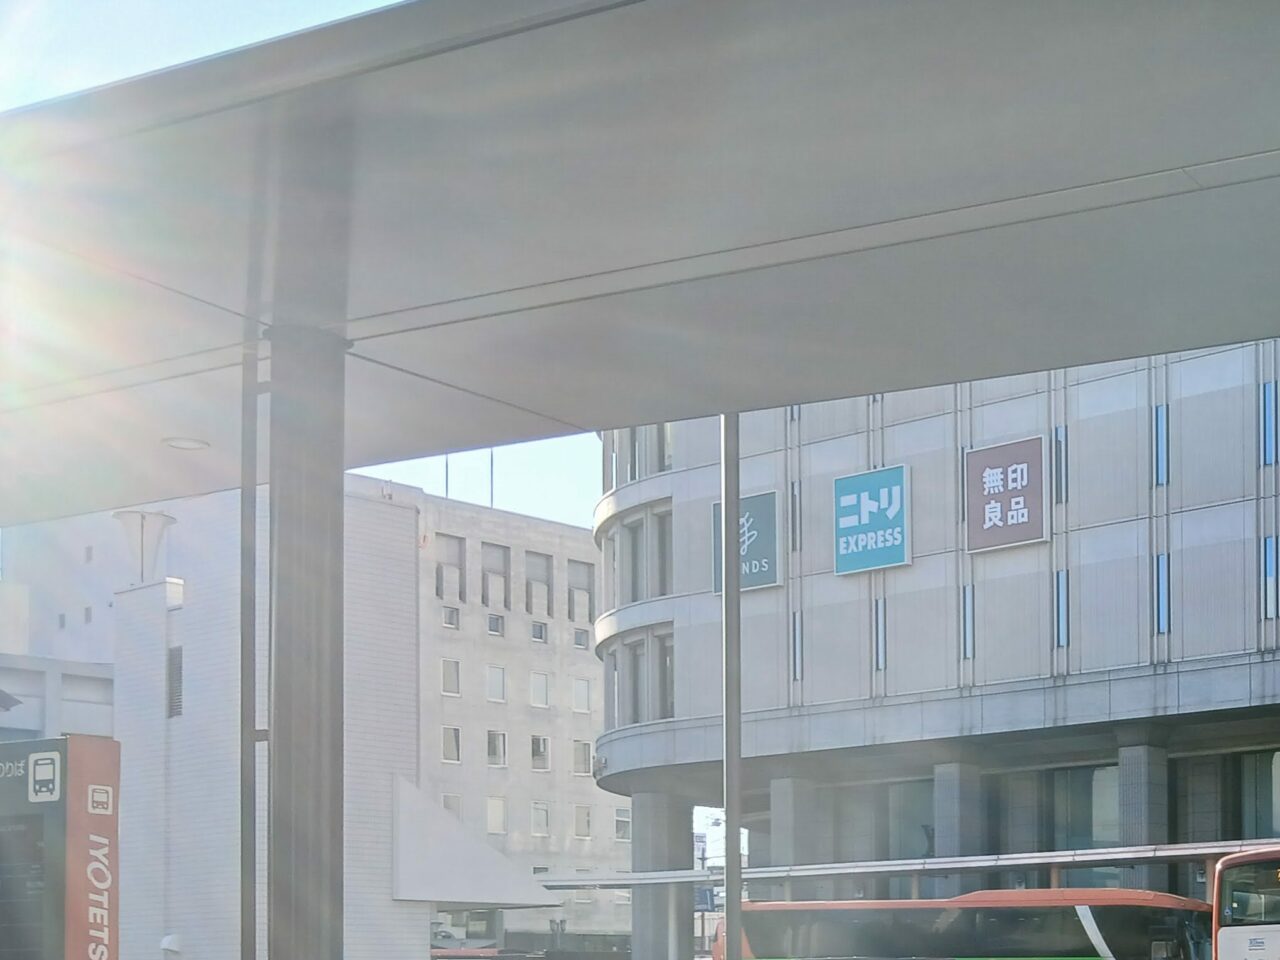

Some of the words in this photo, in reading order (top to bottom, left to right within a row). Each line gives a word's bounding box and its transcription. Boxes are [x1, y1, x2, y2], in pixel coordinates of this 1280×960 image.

[982, 462, 1029, 495] 無印
[839, 485, 901, 529] ニトリ
[982, 496, 1029, 530] 良品
[839, 527, 903, 555] EXPRESS
